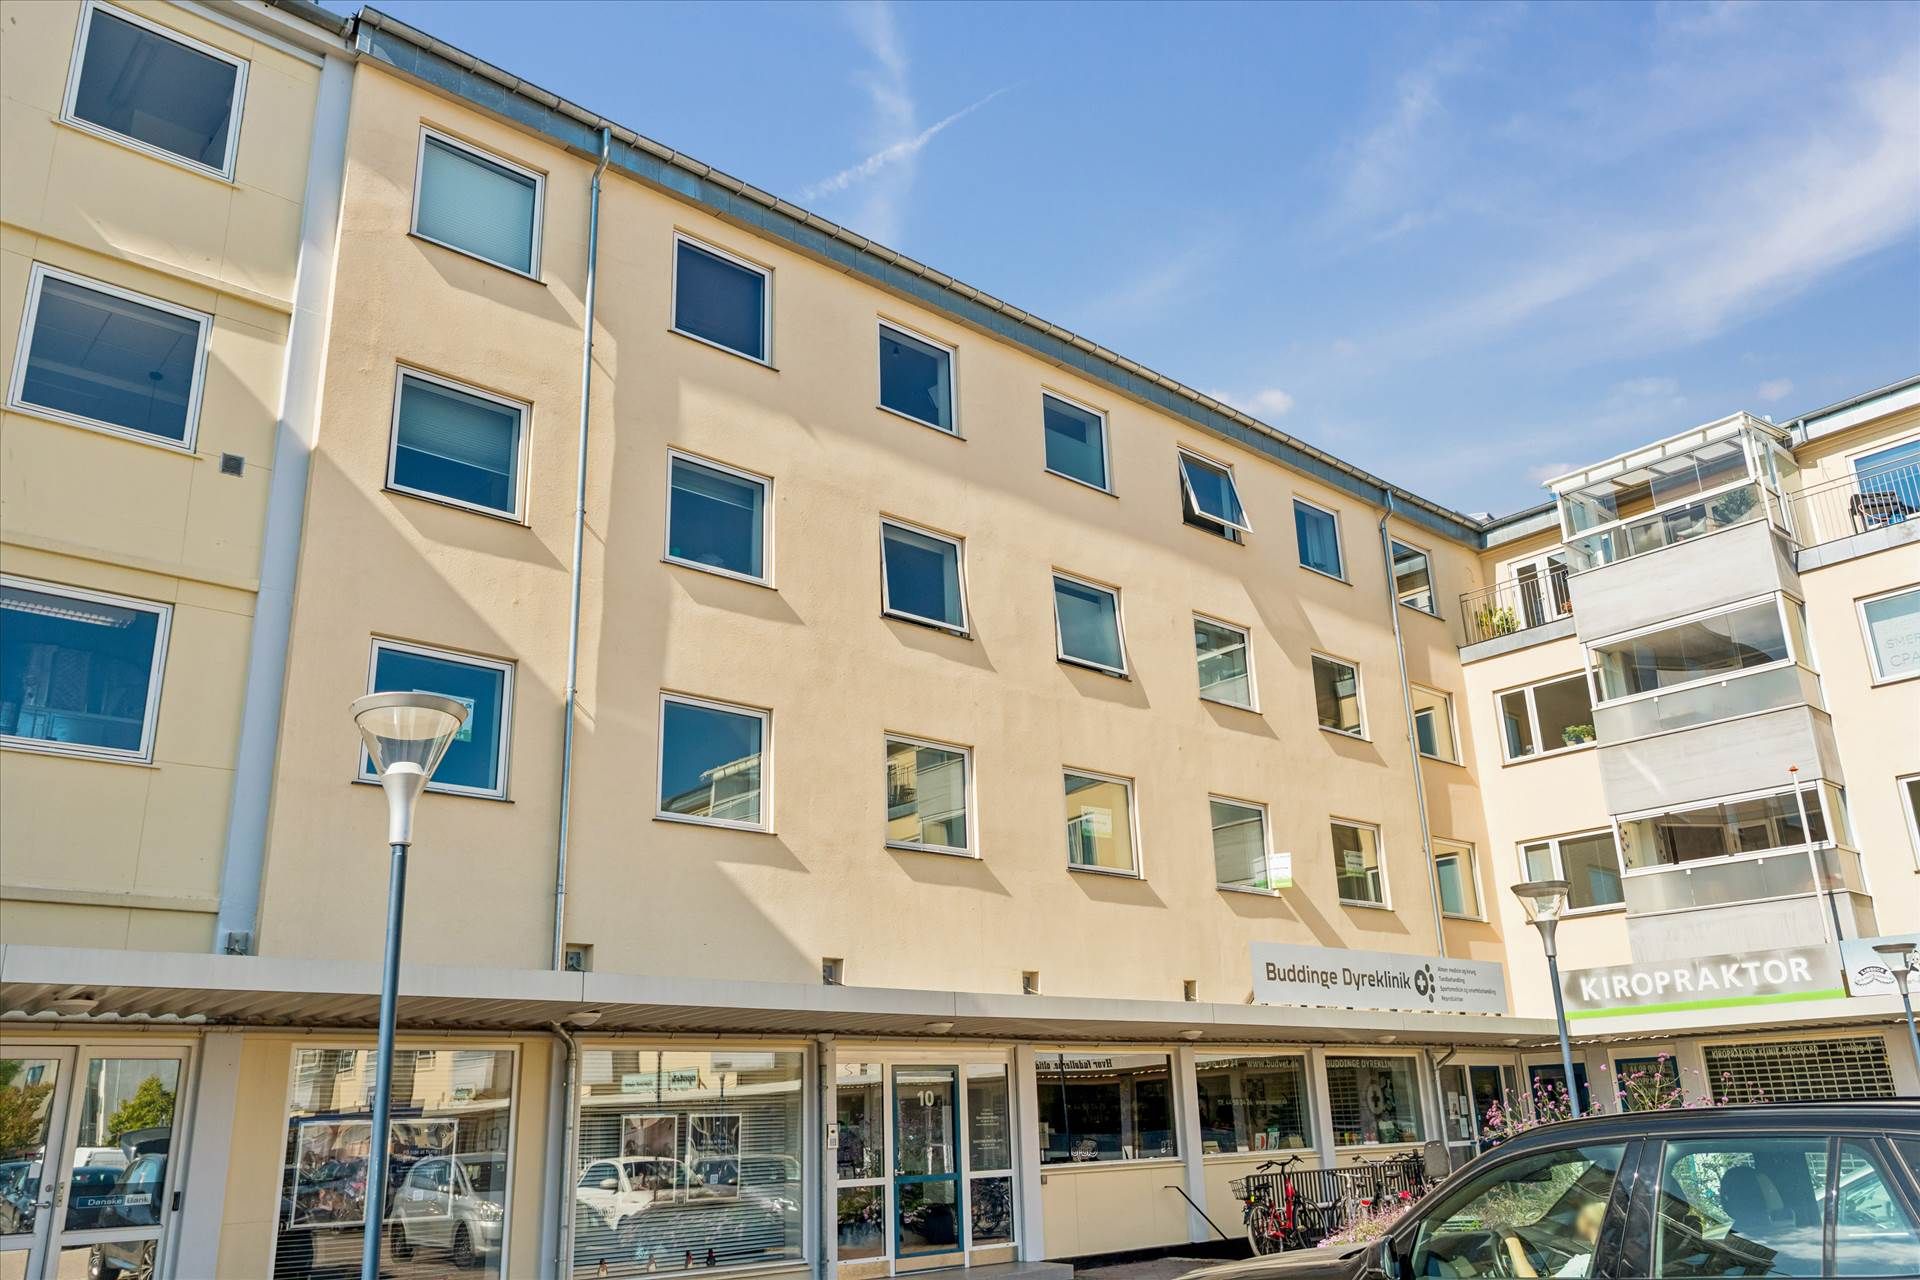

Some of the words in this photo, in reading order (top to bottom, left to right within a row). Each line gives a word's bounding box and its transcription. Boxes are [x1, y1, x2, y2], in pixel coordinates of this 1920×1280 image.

[1265, 962, 1338, 989] Buddinge
[1342, 968, 1412, 991] Dyreklinik
[1580, 957, 1812, 1001] KIROPRAKTOR
[1327, 1060, 1360, 1069] BUDDINGE
[917, 1090, 935, 1106] 10
[88, 1198, 123, 1206] Danske
